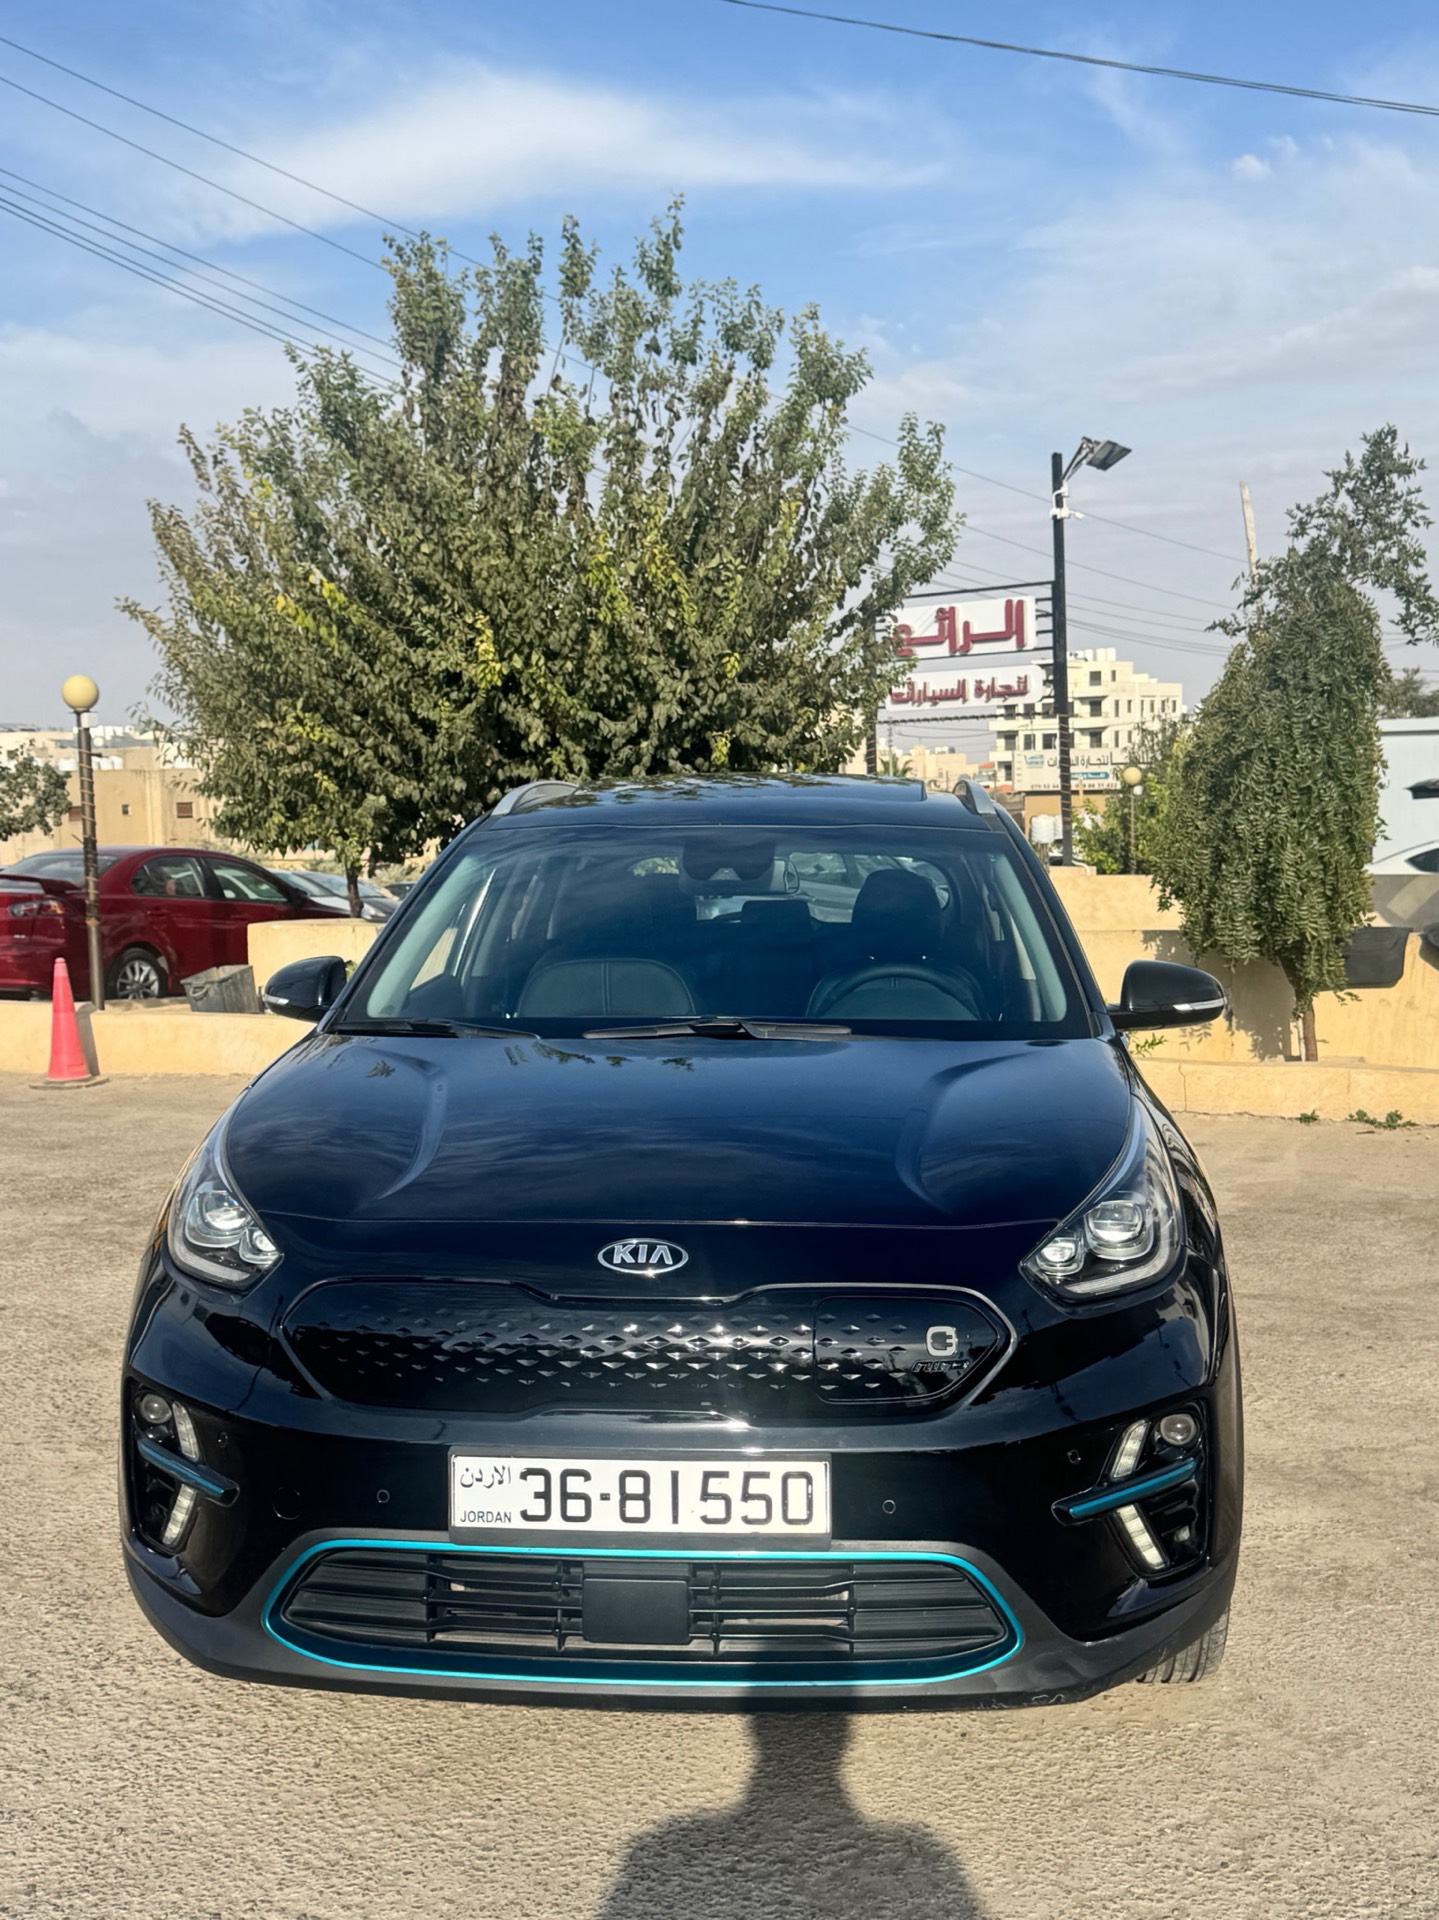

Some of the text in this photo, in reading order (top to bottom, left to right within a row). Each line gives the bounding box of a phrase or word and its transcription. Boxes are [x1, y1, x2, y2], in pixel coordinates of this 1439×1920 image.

[974, 674, 1029, 703] لتجارة
[613, 1244, 674, 1265] KIA
[460, 1465, 512, 1489] الاردن
[519, 1467, 814, 1526] 36-81550
[460, 1510, 512, 1524] JORDAN
